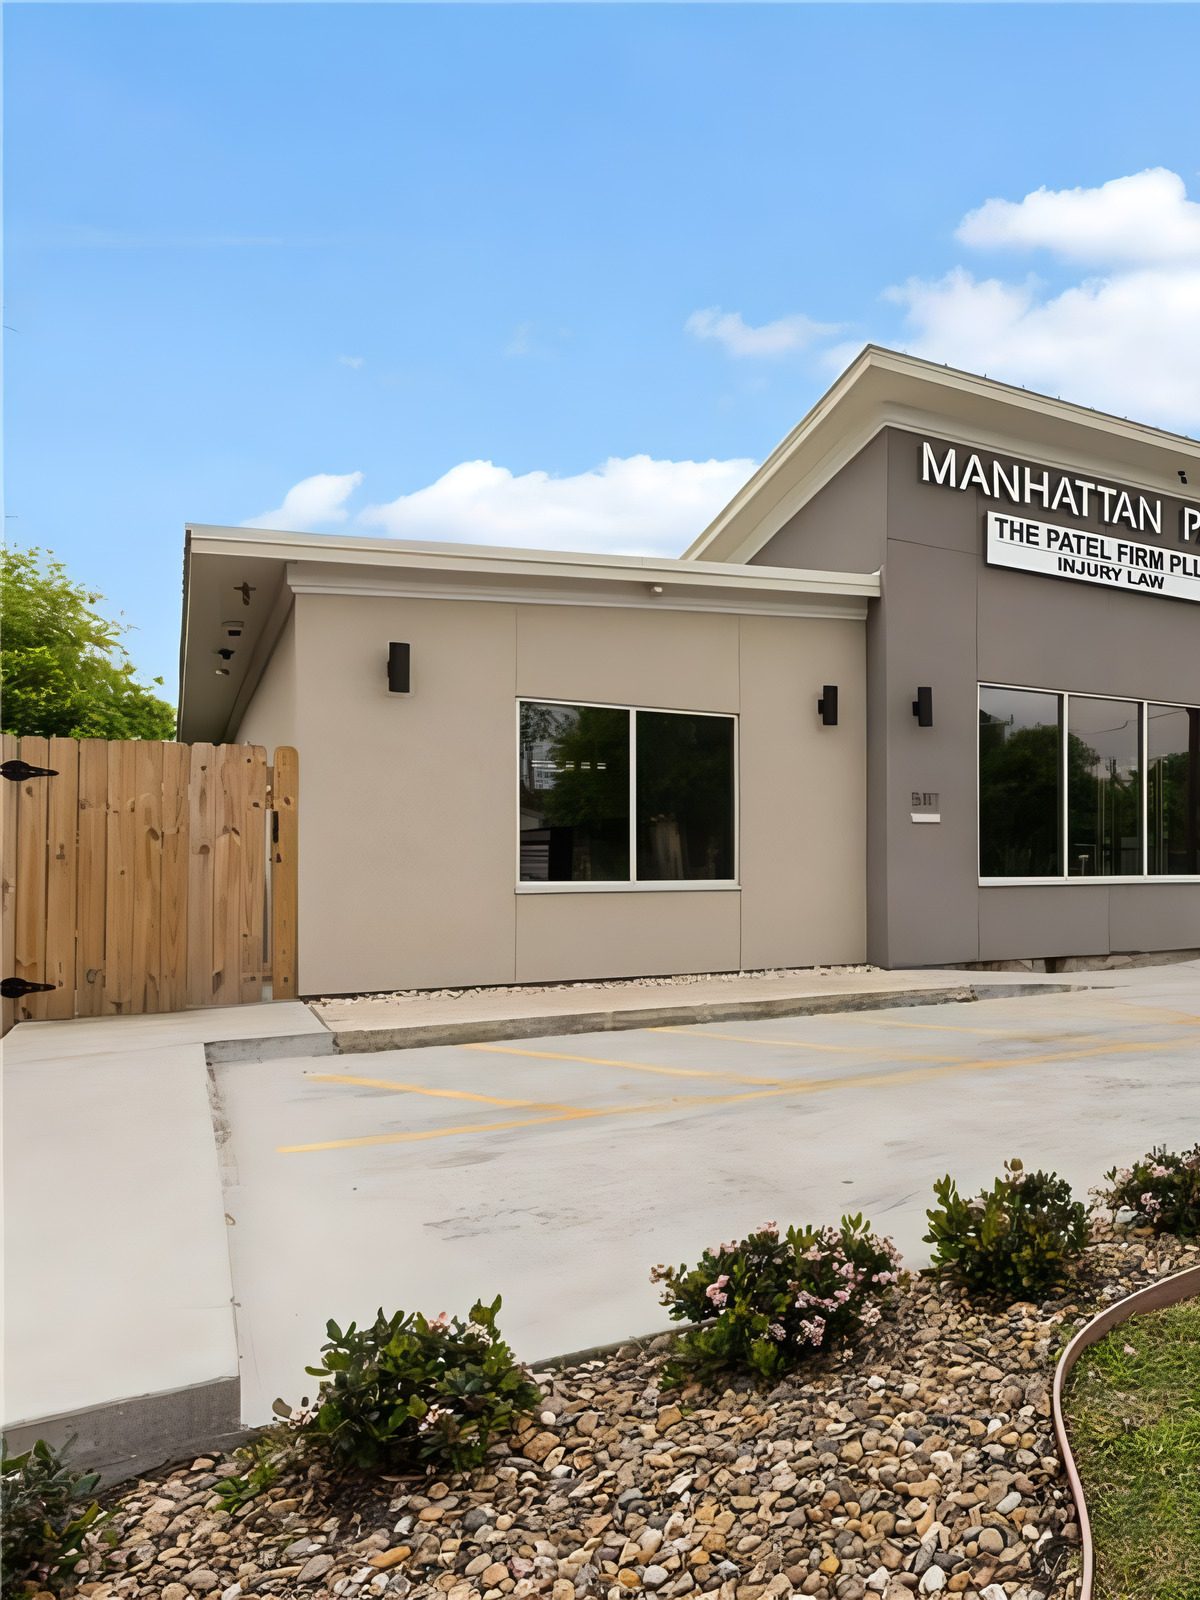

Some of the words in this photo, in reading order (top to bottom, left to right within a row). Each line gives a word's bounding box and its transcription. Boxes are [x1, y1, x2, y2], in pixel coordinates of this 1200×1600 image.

[922, 441, 1162, 535] MANHATTAN
[994, 516, 1040, 546] THE
[1046, 528, 1112, 560] PATEL
[1117, 543, 1164, 571] FIRM
[1058, 556, 1122, 582] INJURY
[1127, 572, 1165, 589] LAW
